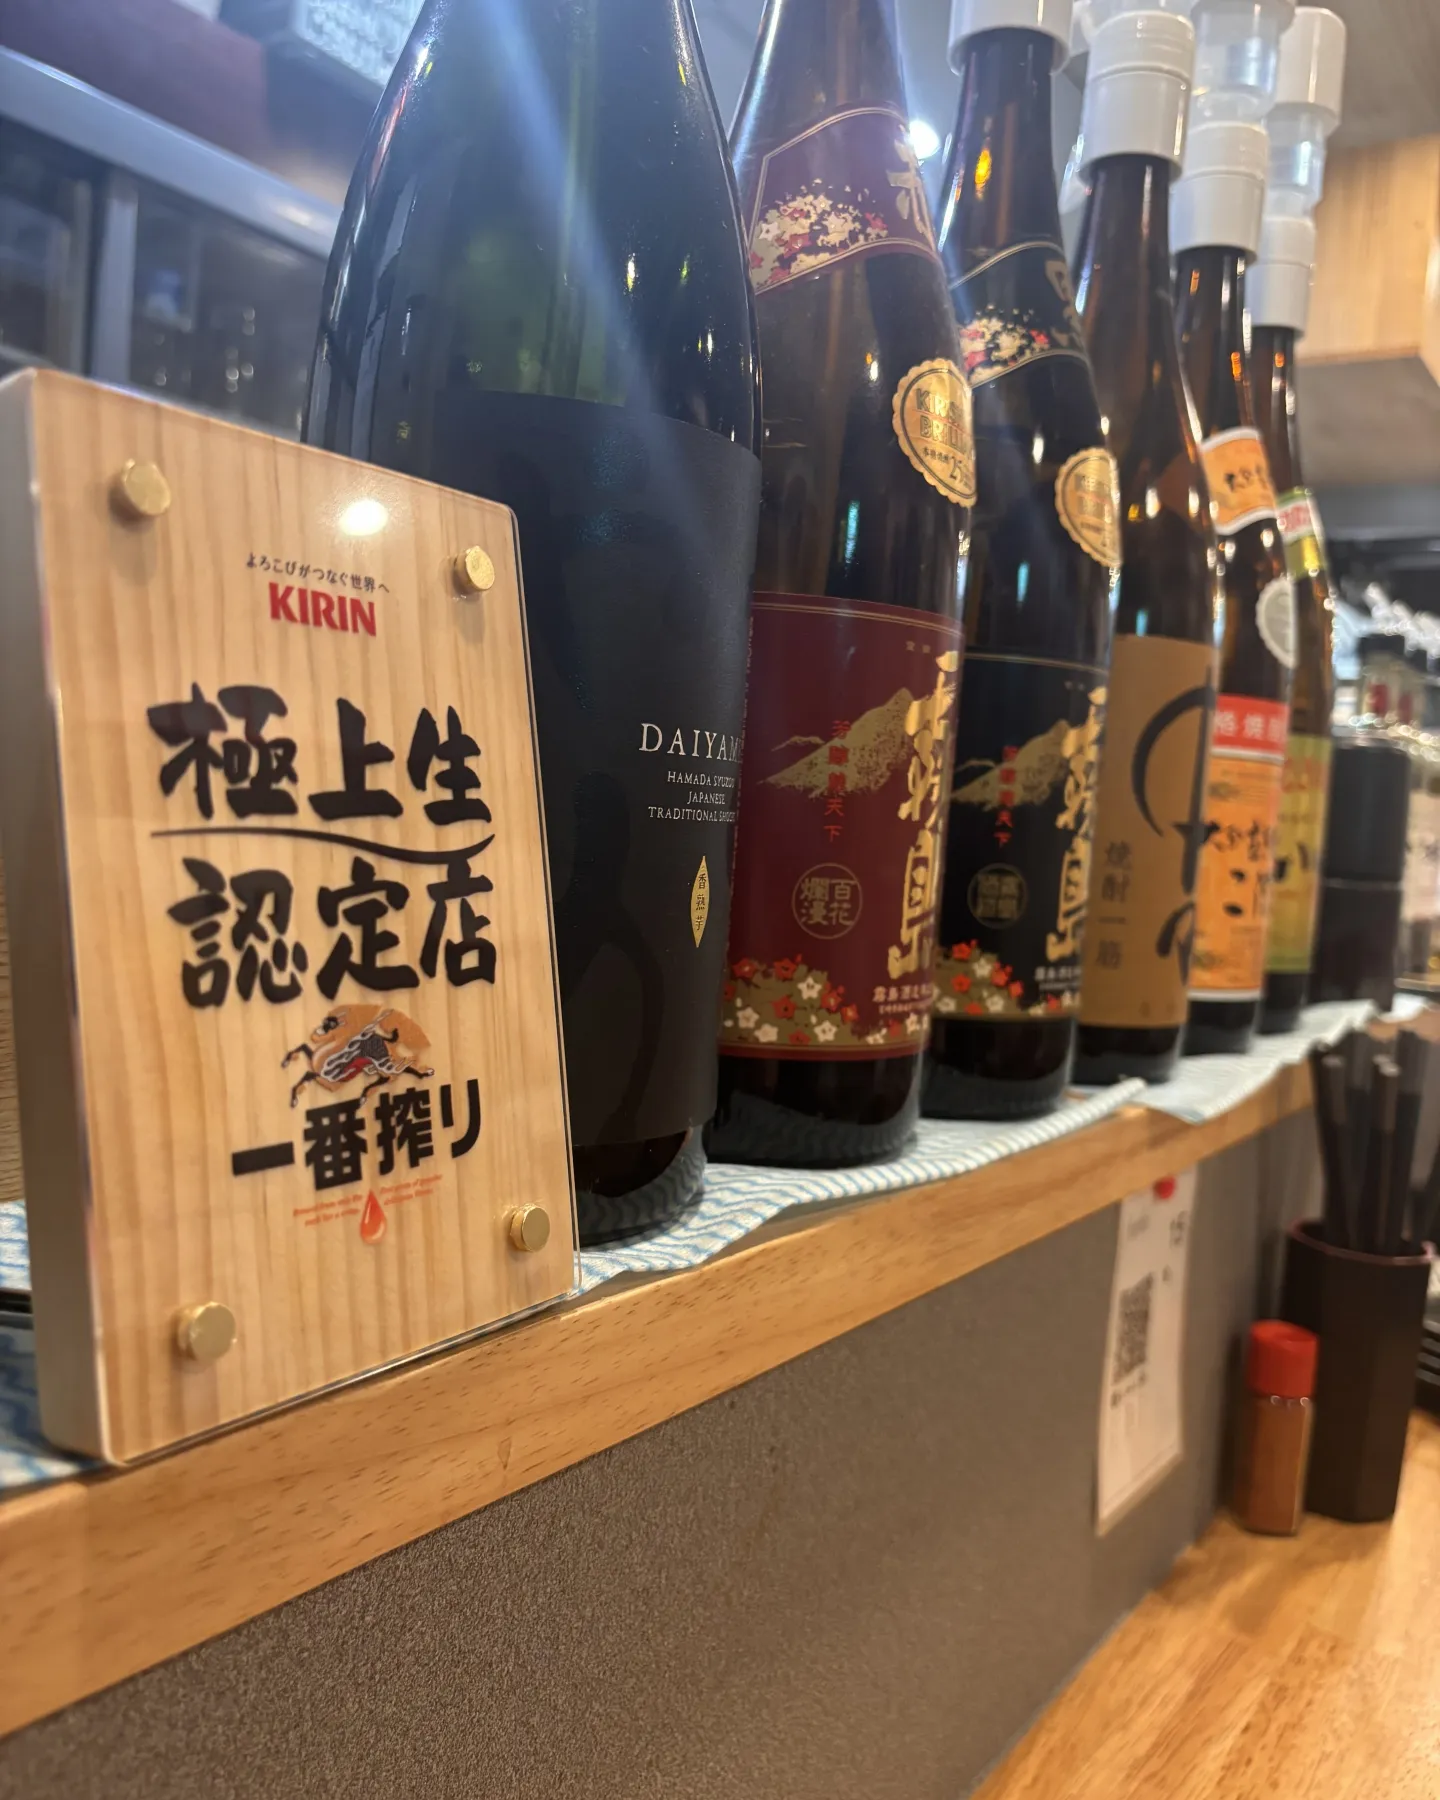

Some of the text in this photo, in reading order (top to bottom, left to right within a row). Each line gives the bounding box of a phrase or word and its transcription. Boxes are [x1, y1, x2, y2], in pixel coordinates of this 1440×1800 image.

[246, 552, 390, 594] よろこびがつなぐ世界へ
[268, 581, 377, 637] KIRIN
[147, 682, 492, 826] 極上生
[667, 770, 712, 786] HAMADA
[648, 806, 718, 822] TRADITIONAL
[687, 791, 726, 804] JAPANESE
[167, 855, 497, 1010] 認定店
[231, 1078, 482, 1191] 一番搾り
